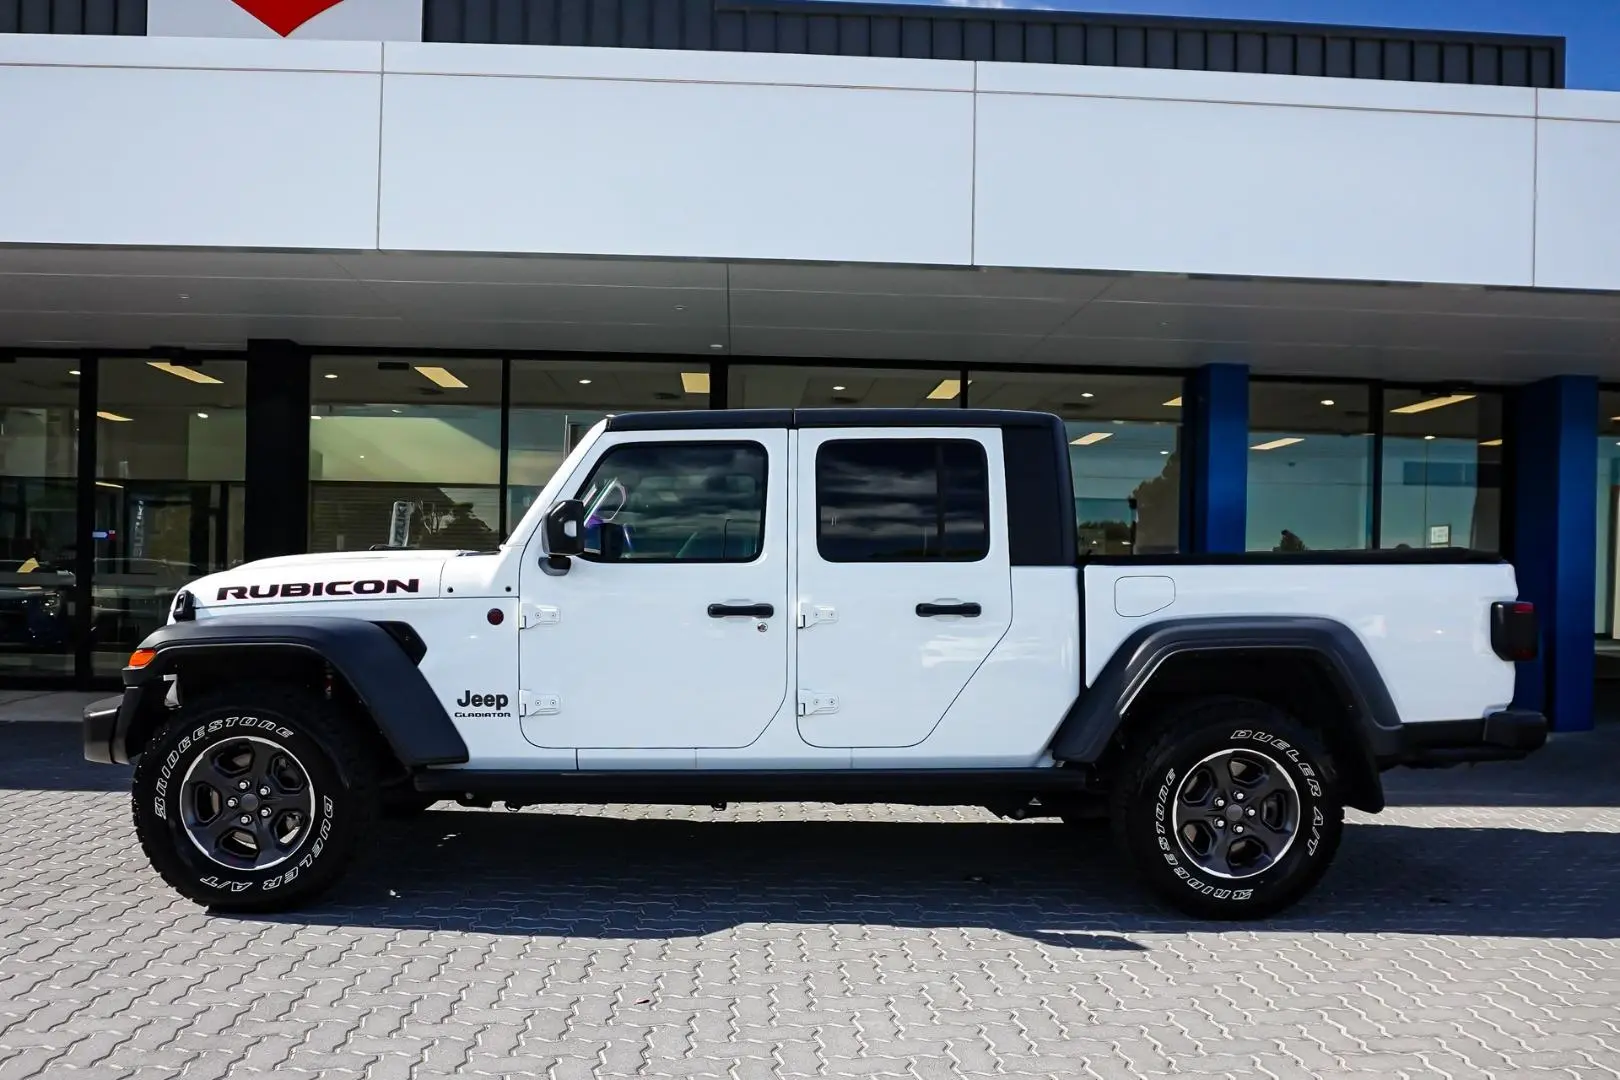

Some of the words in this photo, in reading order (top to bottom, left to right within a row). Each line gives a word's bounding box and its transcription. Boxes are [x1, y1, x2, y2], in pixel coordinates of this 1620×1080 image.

[217, 578, 420, 600] RUBICON
[457, 690, 509, 711] Jeep
[154, 716, 294, 820] BRIDGESTONE
[1230, 729, 1322, 797] DUELER
[1306, 806, 1324, 856] A/T
[262, 796, 333, 891] DUELER
[1155, 768, 1254, 900] BRIDGESTONE
[200, 877, 253, 893] A/T
